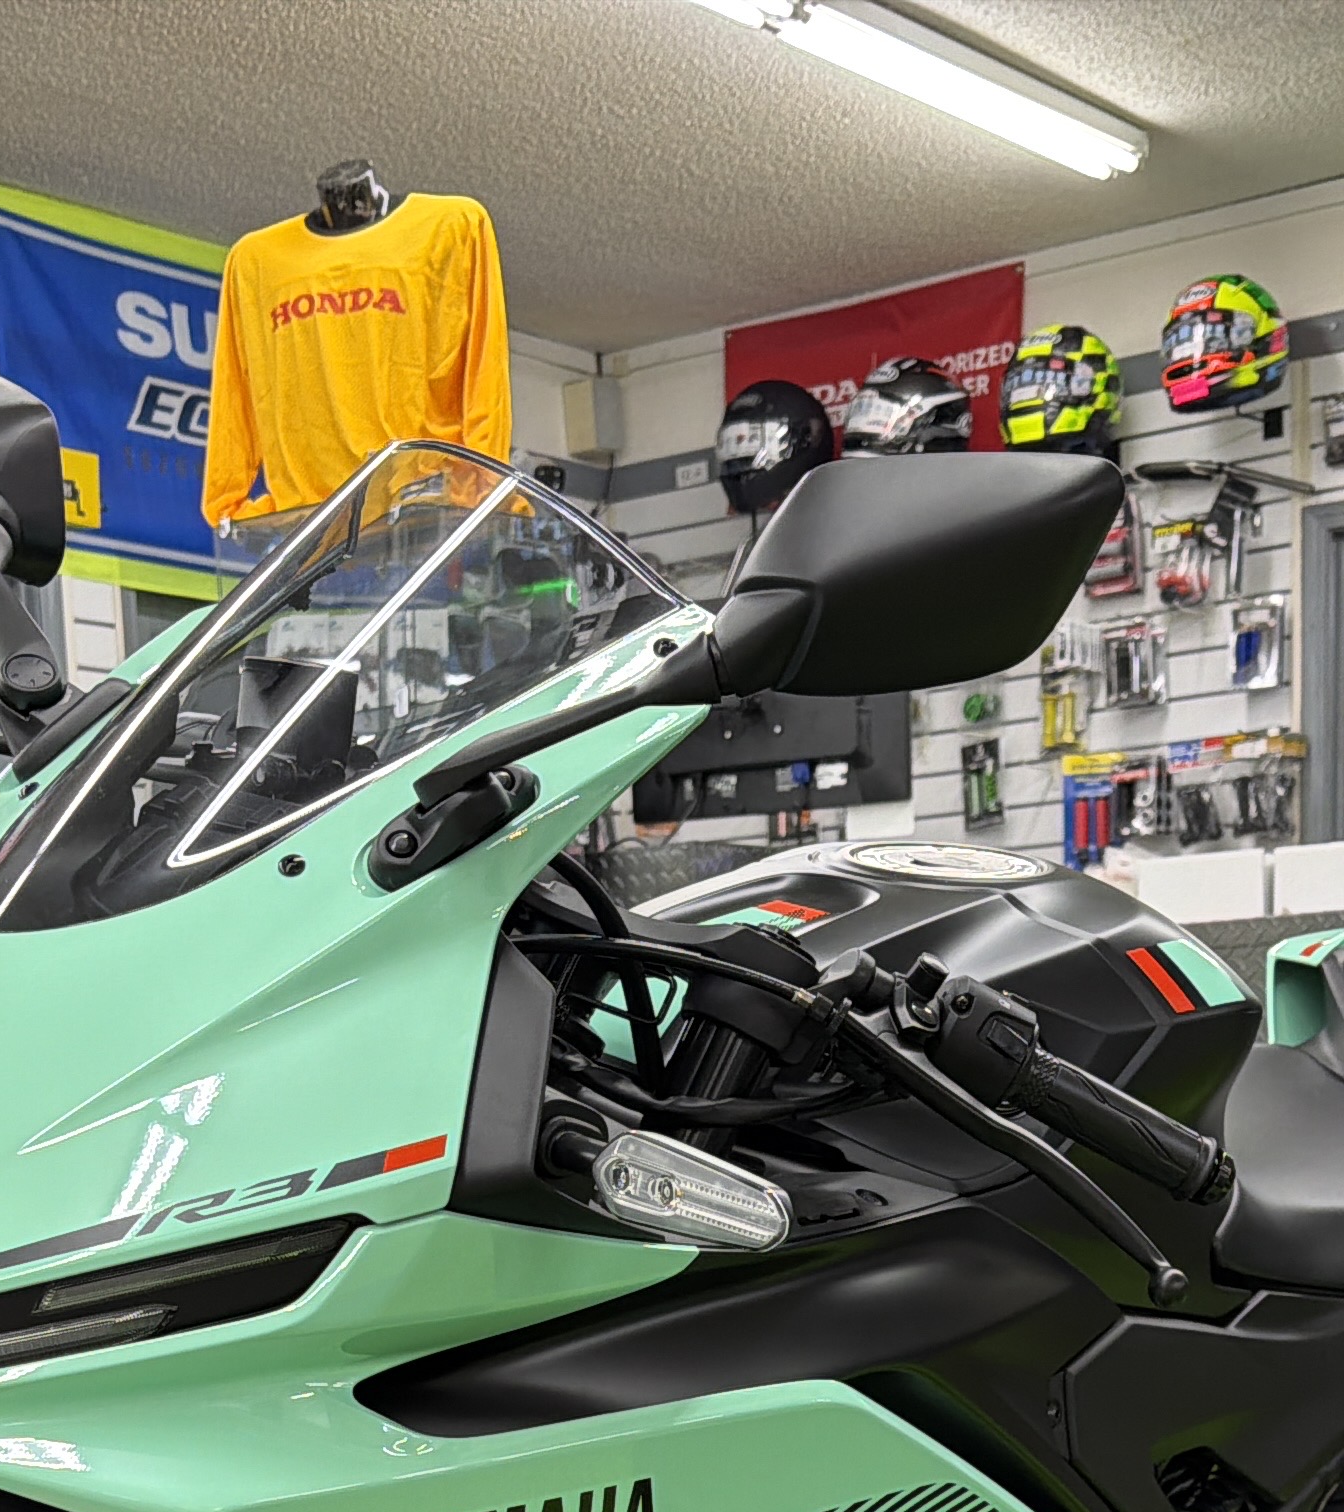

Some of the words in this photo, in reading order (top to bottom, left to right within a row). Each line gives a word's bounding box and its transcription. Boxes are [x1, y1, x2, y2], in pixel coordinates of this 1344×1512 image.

[270, 287, 406, 333] HONDA
[938, 341, 1016, 376] ORIZED
[135, 1168, 318, 1237] R3
